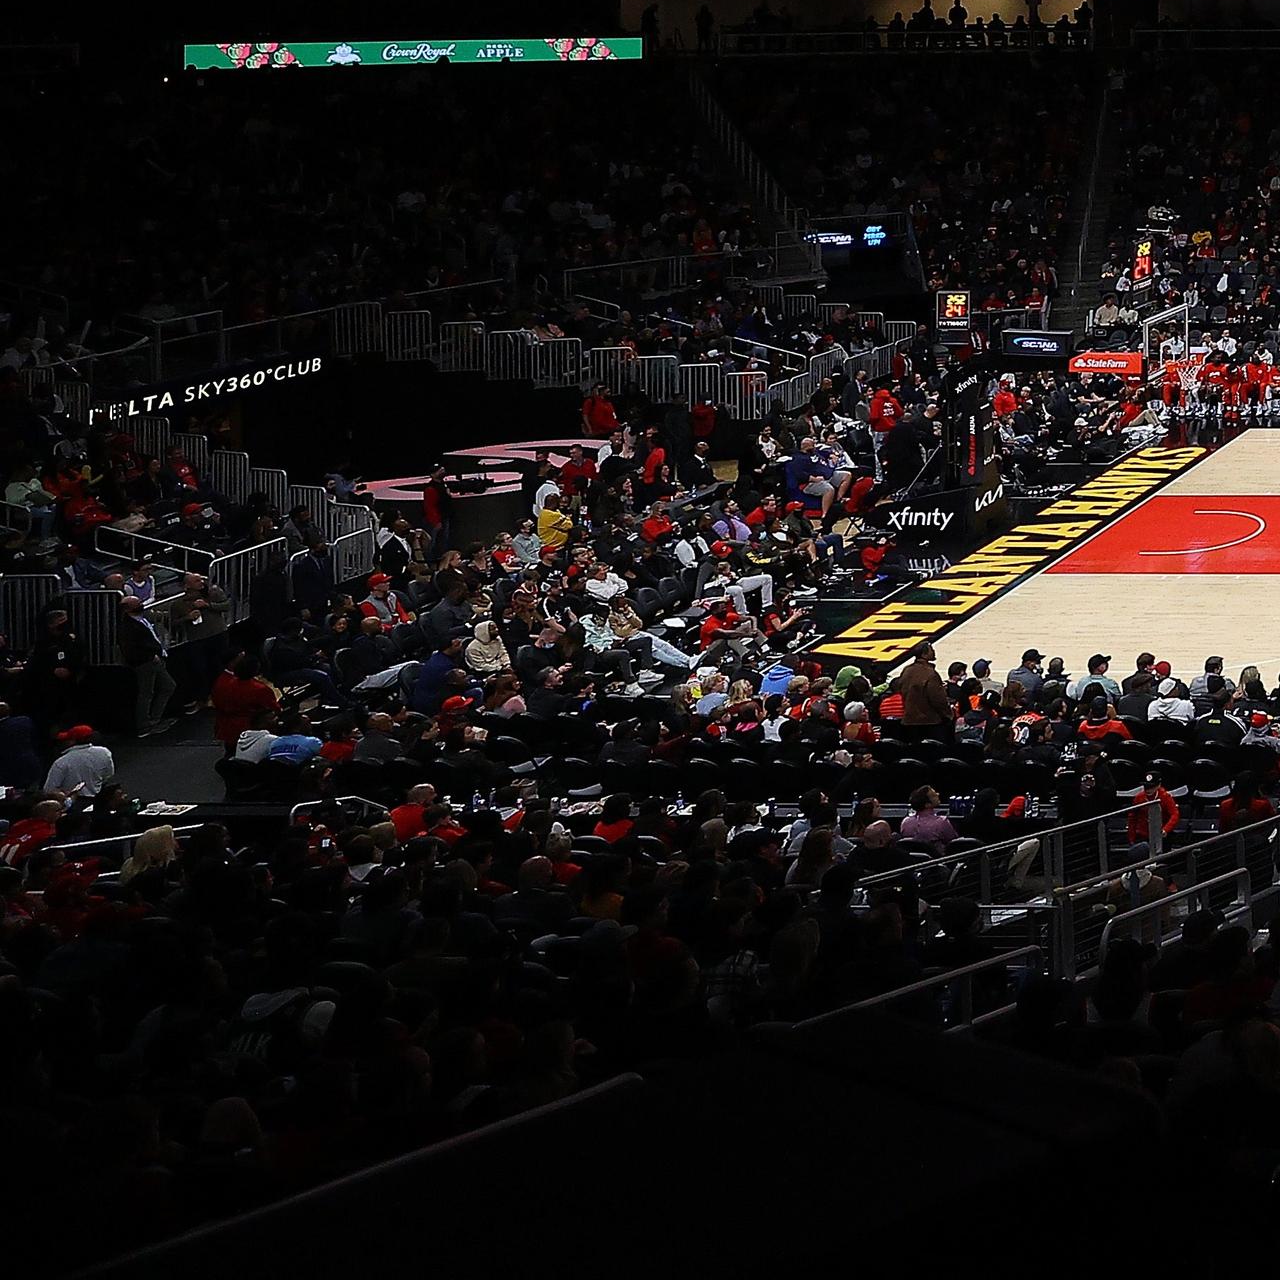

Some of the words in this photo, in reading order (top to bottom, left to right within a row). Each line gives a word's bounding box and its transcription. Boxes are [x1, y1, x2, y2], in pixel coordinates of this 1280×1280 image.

[476, 48, 524, 58] APPLE
[1134, 256, 1149, 279] 24
[1021, 341, 1058, 349] SCANA
[954, 374, 978, 395] xfinity
[886, 505, 954, 531] xfinity
[812, 518, 1101, 662] ATLANTA
[1036, 446, 1208, 518] HAWKS
